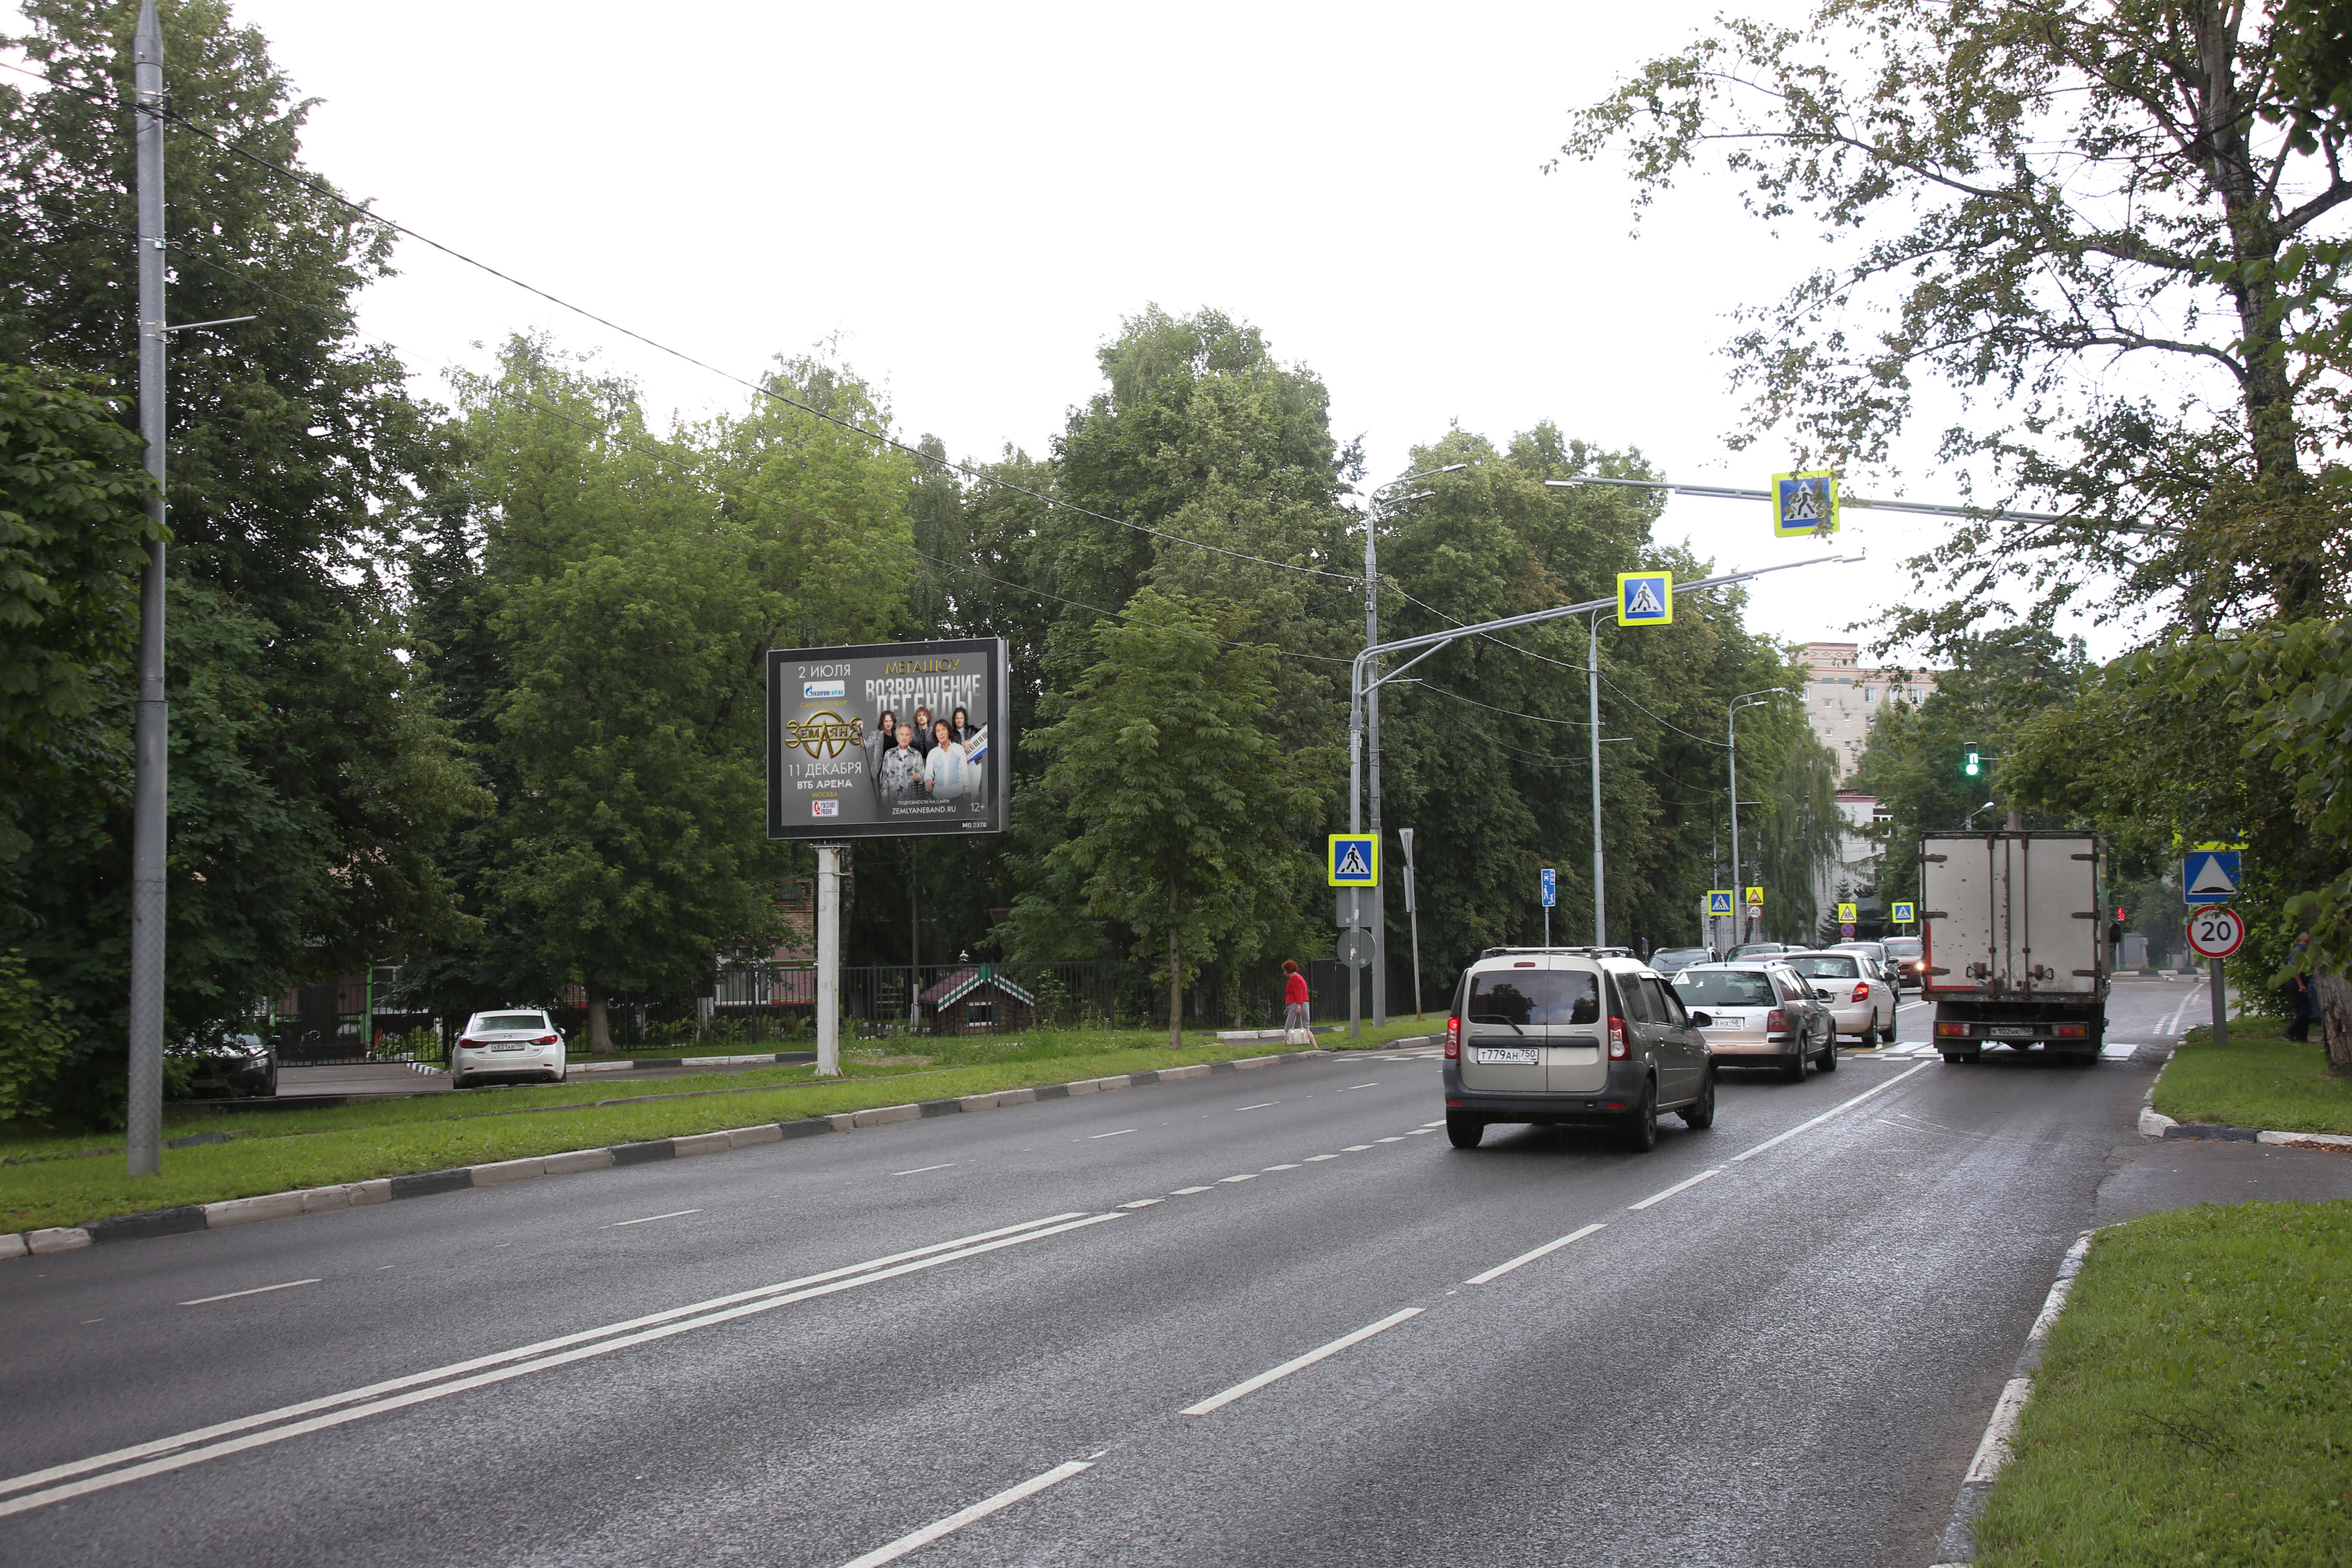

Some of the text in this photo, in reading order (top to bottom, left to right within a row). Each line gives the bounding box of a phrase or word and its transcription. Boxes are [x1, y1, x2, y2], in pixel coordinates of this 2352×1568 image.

[798, 664, 850, 678] 2 ИЮЛЯ
[885, 658, 960, 674] МЕГАШОУ
[866, 674, 981, 701] ВОЗВРАЩЕНИЕ
[789, 762, 861, 778] 11 ДЕКАБРЯ
[797, 780, 853, 790] ВТБ АРЕНА
[892, 806, 956, 815] ZEMLYANEBAND.RU
[971, 802, 985, 812] 12+
[2201, 921, 2231, 941] 20
[1481, 1050, 1518, 1060] Т779АН
